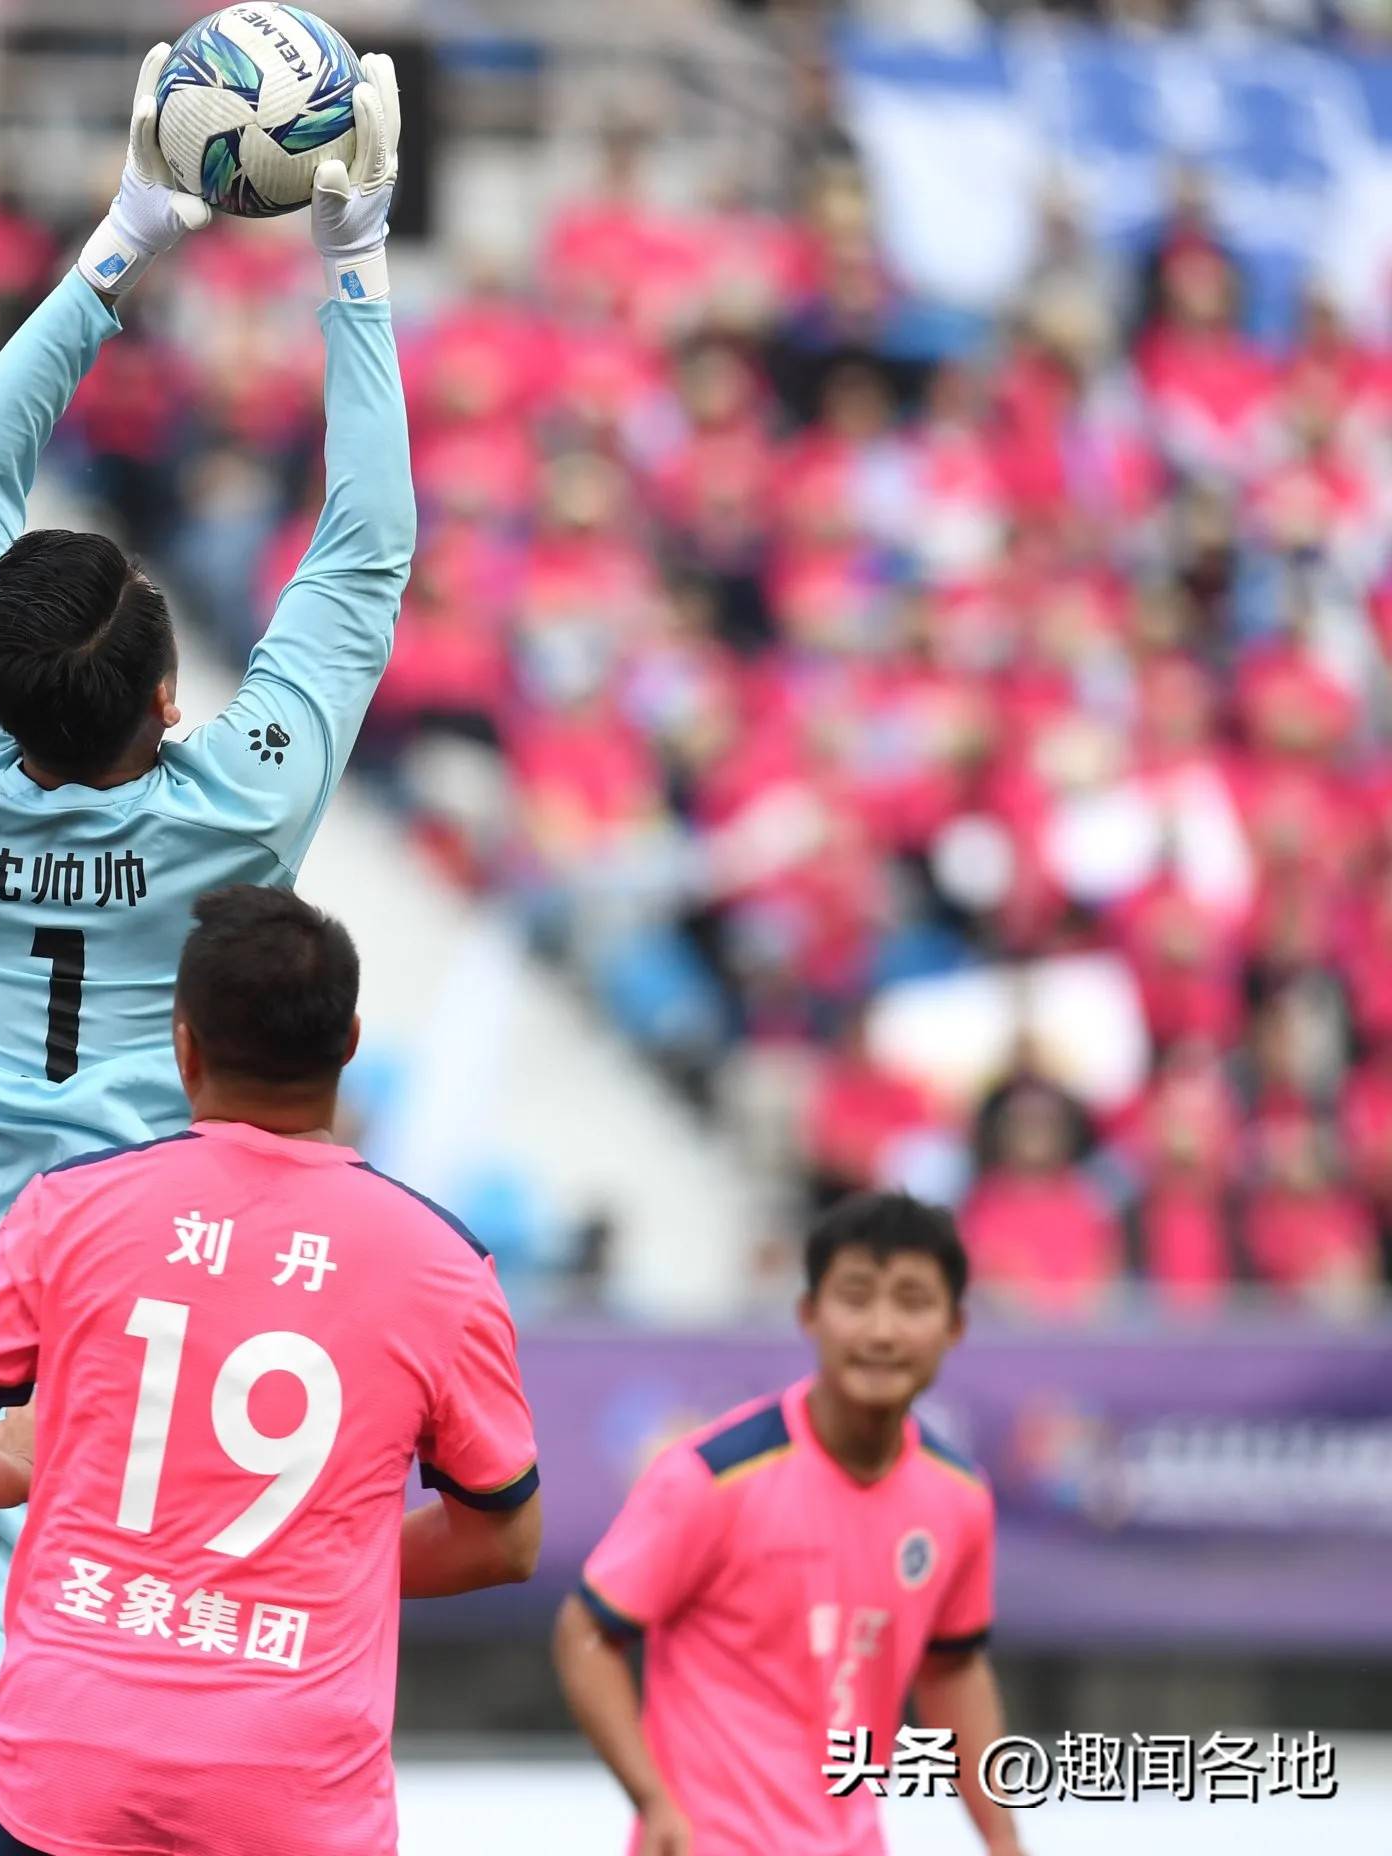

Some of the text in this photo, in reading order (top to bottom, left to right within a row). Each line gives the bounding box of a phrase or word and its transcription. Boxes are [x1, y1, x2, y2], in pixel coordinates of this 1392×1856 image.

[241, 12, 312, 82] KELME
[30, 926, 85, 1084] 1
[116, 1297, 343, 1559] 19
[54, 1556, 310, 1670] 圣象集团
